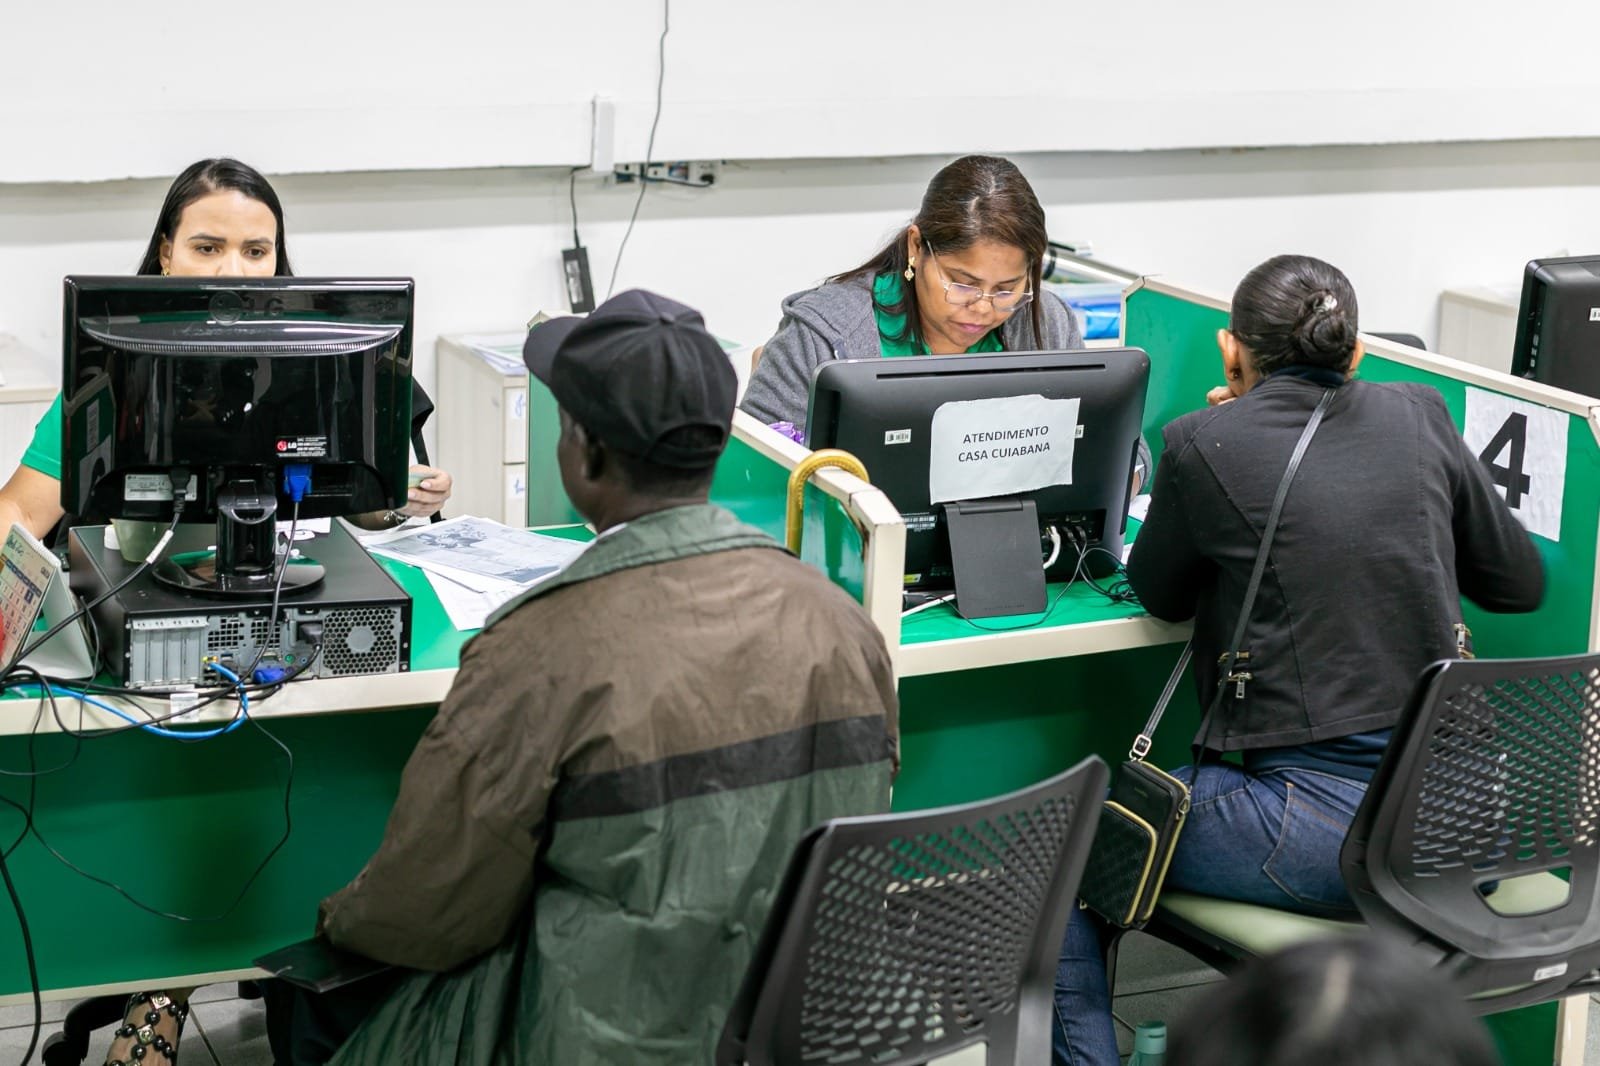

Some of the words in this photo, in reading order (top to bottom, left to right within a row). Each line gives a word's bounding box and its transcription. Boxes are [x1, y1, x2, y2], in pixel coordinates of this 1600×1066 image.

[963, 425, 1049, 444] ATENDIMENTO
[958, 449, 988, 462] CASA
[991, 442, 1051, 459] CUIABANA
[1479, 412, 1531, 509] 4
